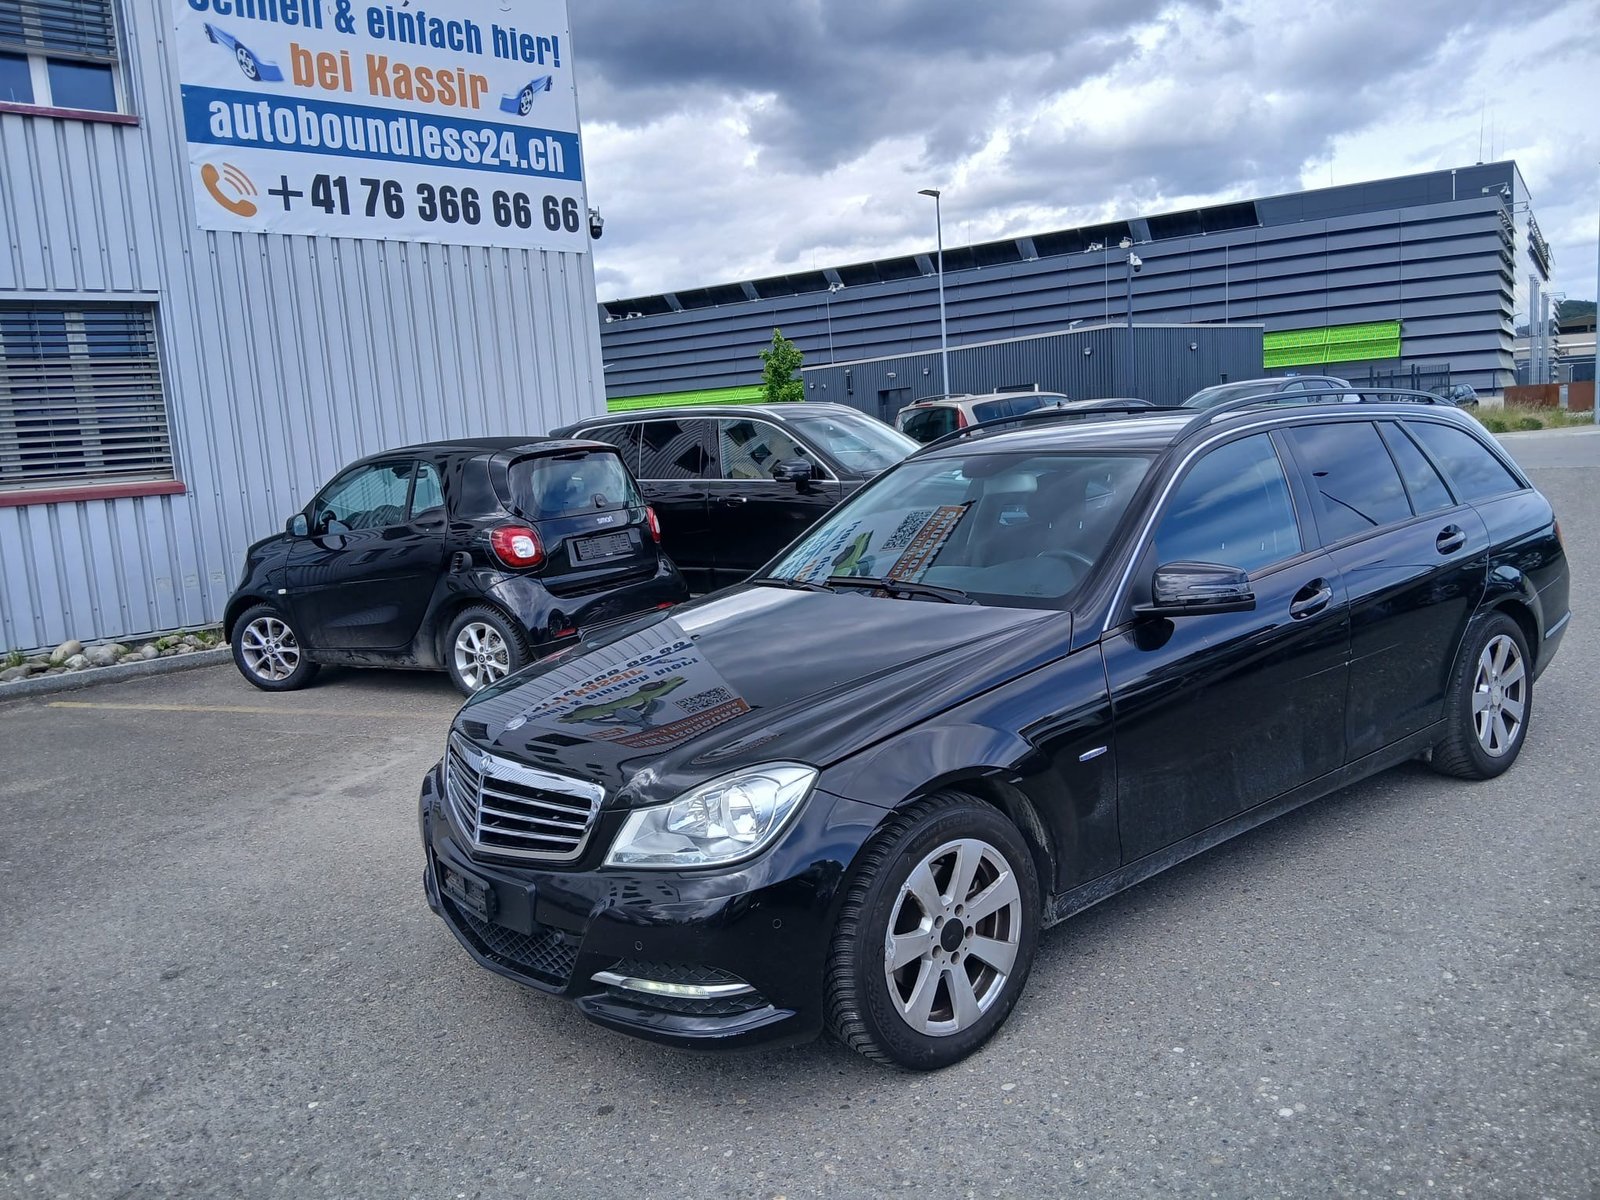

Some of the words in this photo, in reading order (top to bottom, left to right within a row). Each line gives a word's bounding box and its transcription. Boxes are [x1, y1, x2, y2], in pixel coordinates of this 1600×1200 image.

[335, 0, 356, 34] &
[366, 6, 483, 55] einfach
[492, 24, 560, 68] hier!
[290, 43, 352, 92] bei
[366, 54, 488, 109] Kassir
[209, 100, 564, 173] autoboundless24.ch
[311, 174, 350, 215] 41
[360, 178, 405, 219] 76
[417, 183, 481, 225] 366
[492, 190, 532, 229] 66
[542, 195, 579, 232] 66
